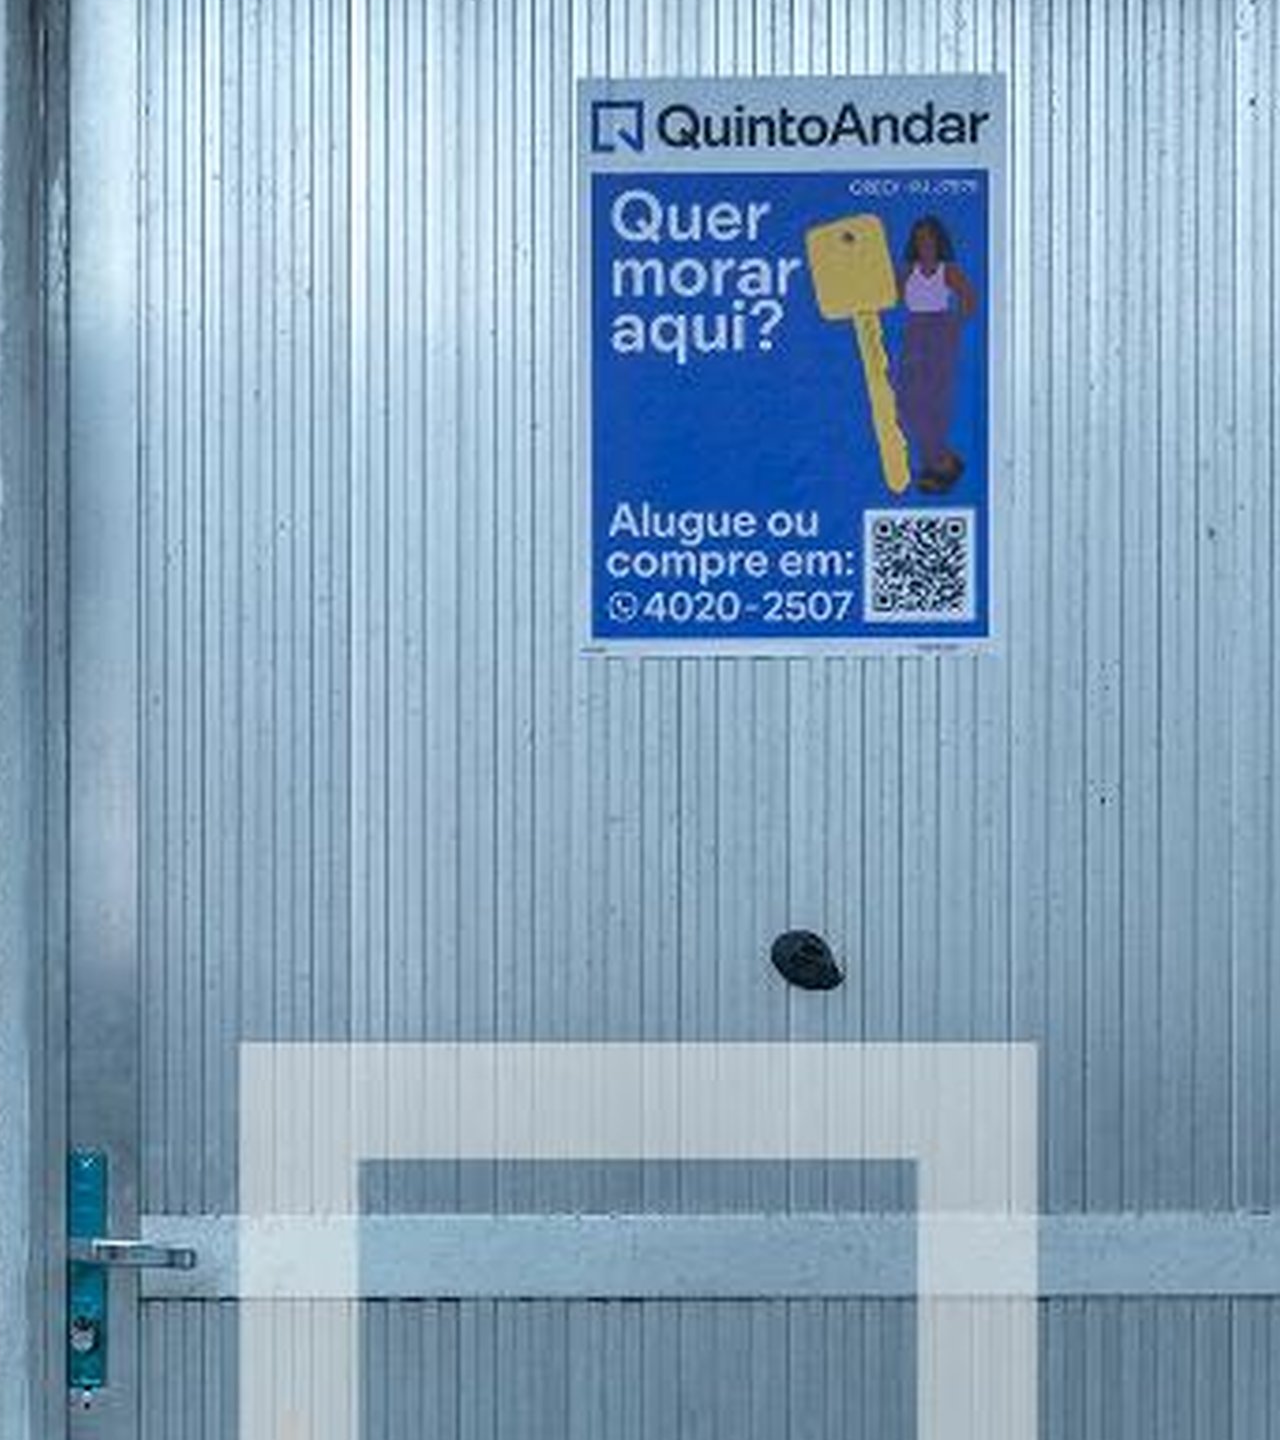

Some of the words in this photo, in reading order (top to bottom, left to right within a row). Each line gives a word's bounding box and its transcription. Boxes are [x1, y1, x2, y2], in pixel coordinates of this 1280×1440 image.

[656, 103, 990, 149] QuintoAndar
[611, 190, 771, 242] Quer
[612, 257, 799, 297] morar
[611, 300, 783, 363] aqui?
[609, 502, 757, 545] Alugue
[766, 512, 819, 538] ou
[607, 550, 768, 586] compre
[778, 552, 855, 578] em:
